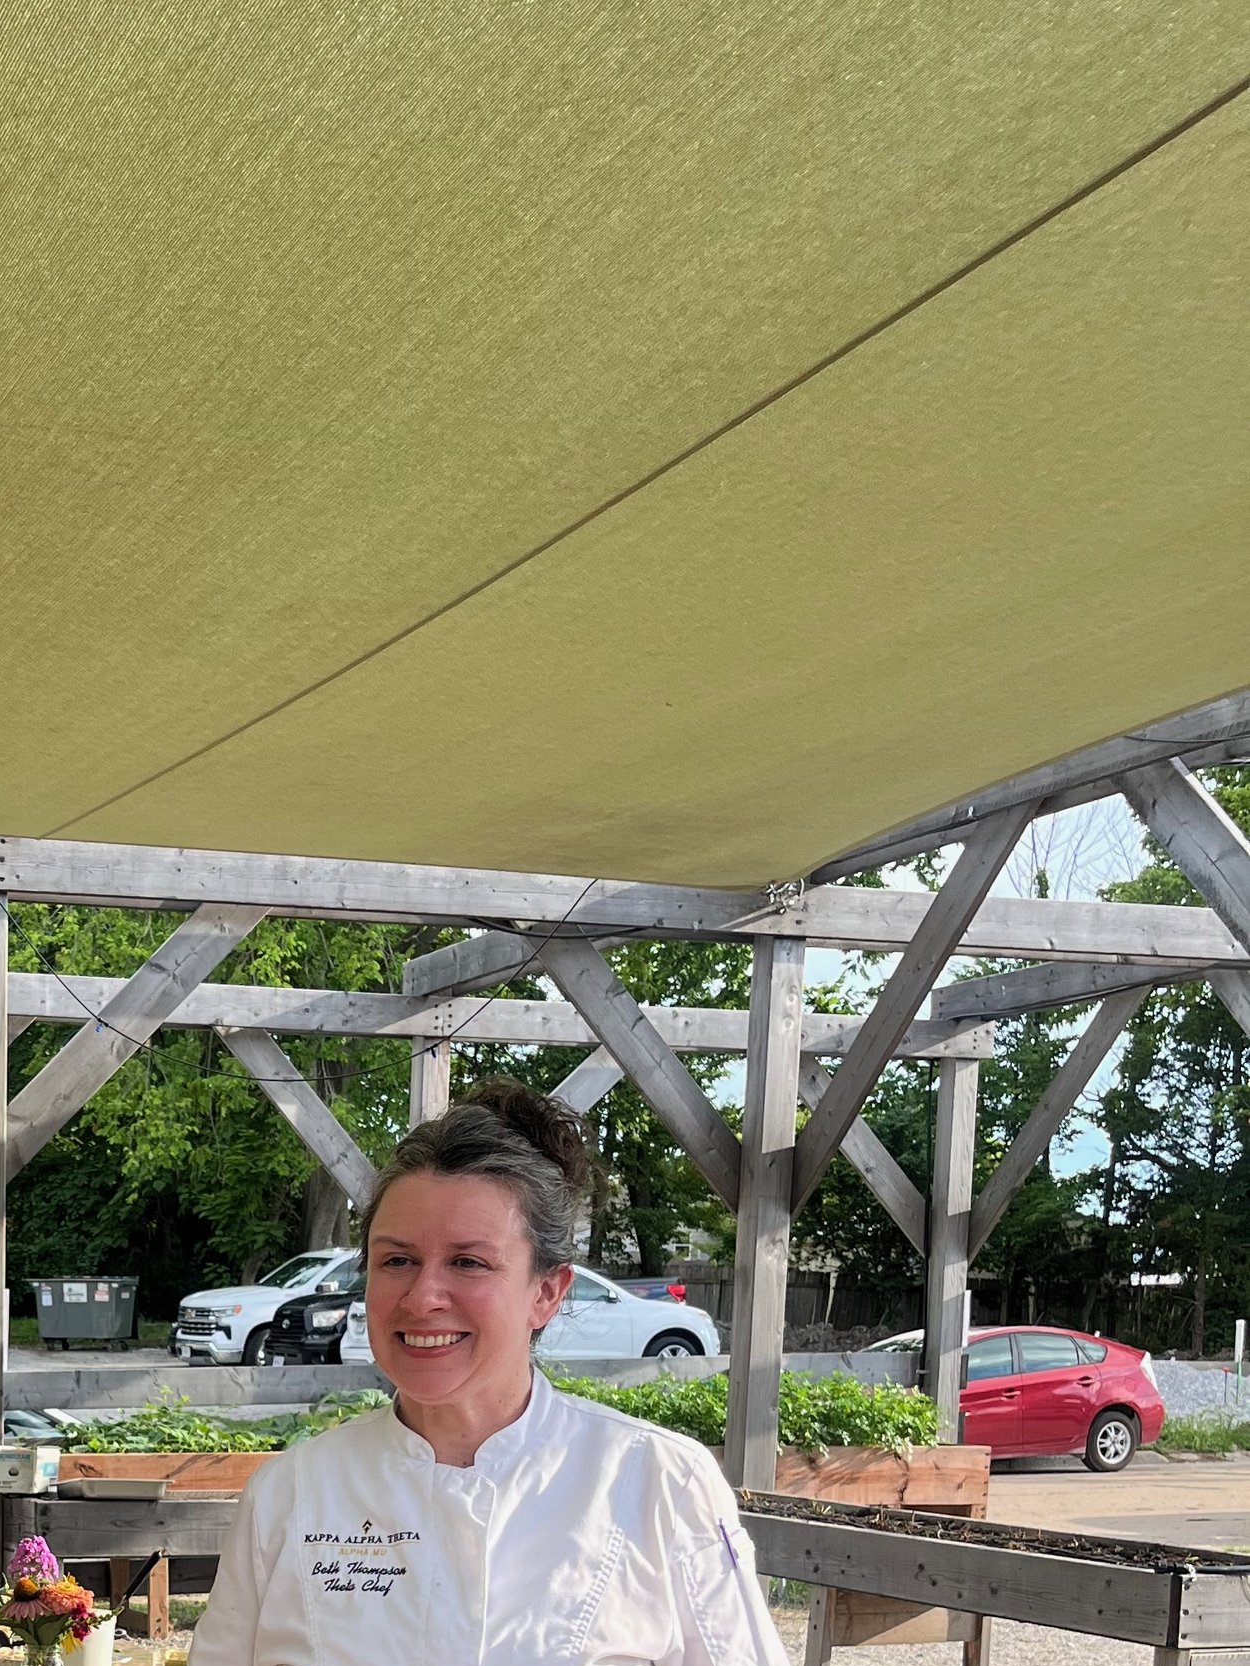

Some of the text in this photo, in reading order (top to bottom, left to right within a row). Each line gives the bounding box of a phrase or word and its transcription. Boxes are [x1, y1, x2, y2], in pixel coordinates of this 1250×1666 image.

[304, 1532, 420, 1544] KAPPA ALPHA THETA
[338, 1548, 386, 1556] ALPHA MU
[312, 1561, 406, 1580] Beth Thompson
[362, 1580, 393, 1597] Chef
